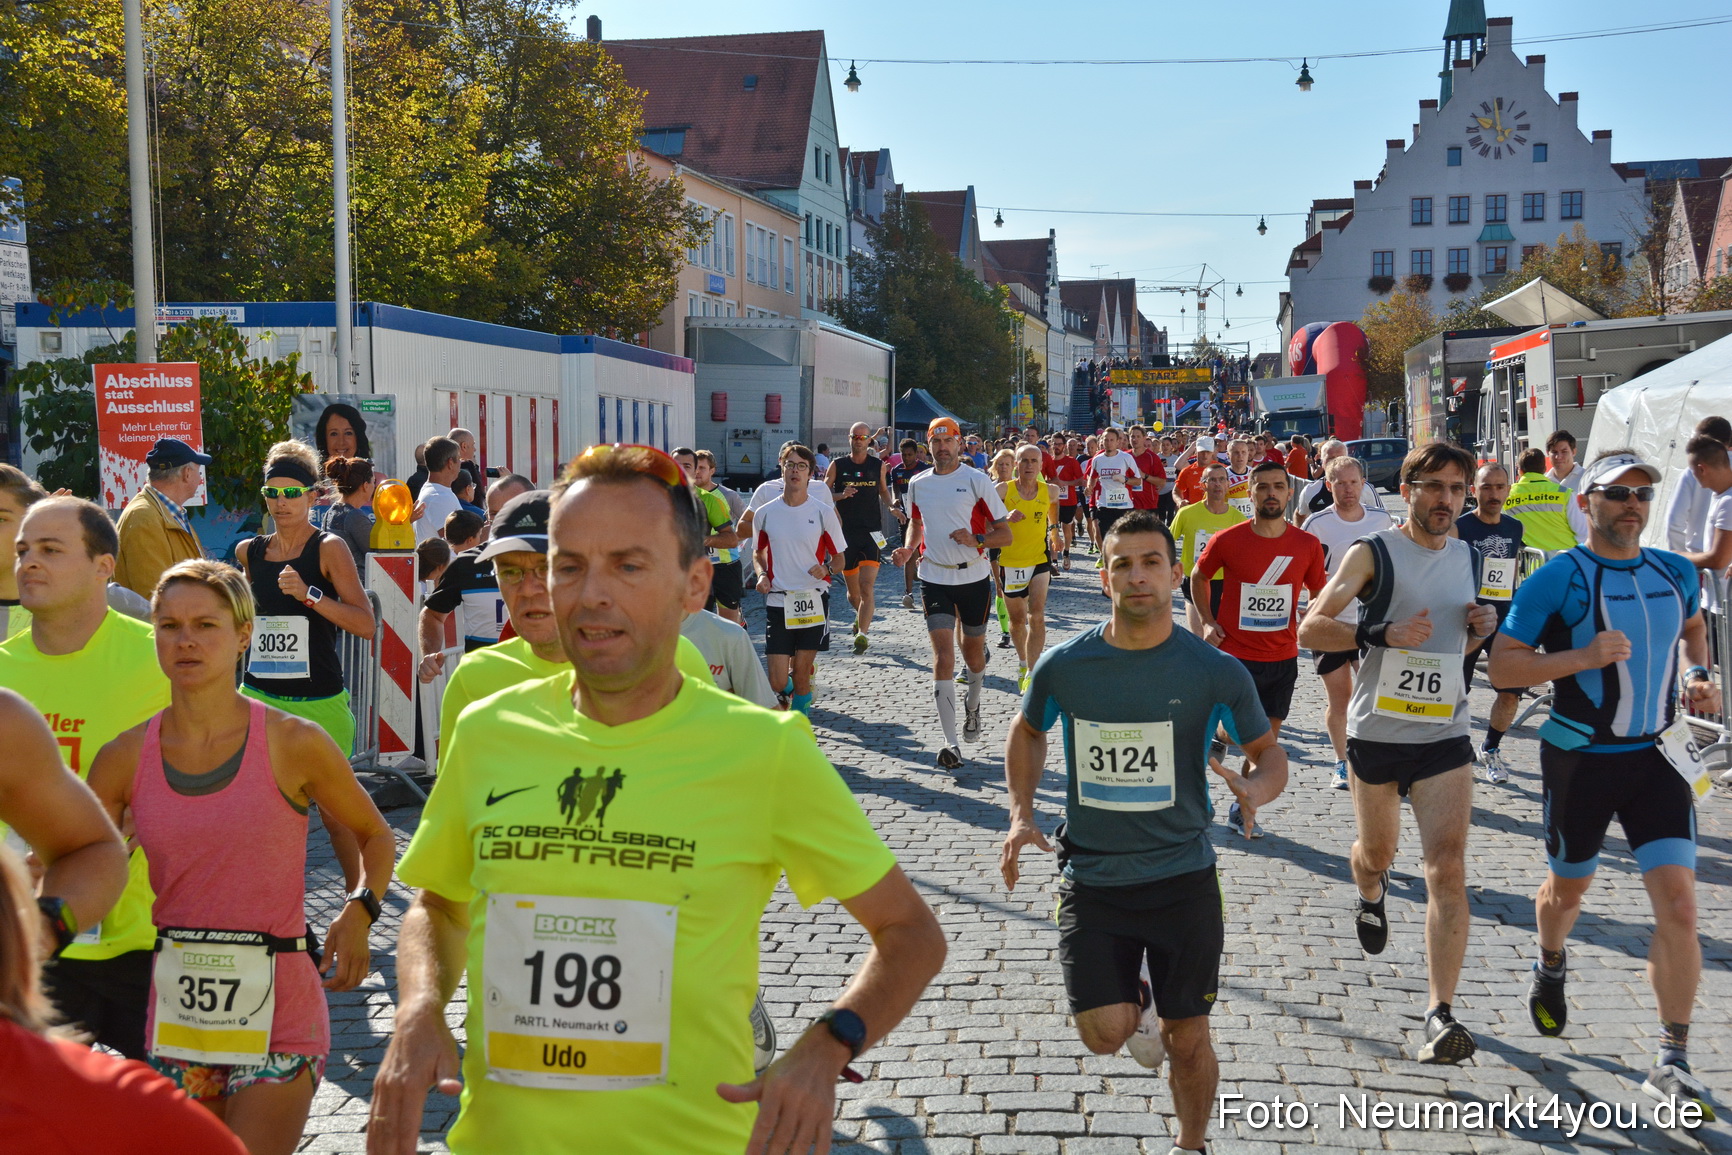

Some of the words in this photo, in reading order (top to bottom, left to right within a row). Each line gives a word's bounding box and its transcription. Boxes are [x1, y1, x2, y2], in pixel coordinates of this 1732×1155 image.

[3, 270, 26, 281] werktags
[104, 373, 193, 389] Abschluss
[1143, 372, 1177, 381] START
[104, 390, 135, 400] statt
[1274, 393, 1306, 401] BOCK
[106, 400, 195, 414] Ausschluss!
[122, 423, 148, 432] Mehr
[149, 422, 178, 432] Lehrer
[180, 422, 192, 431] für
[118, 433, 156, 443] kleinere
[1229, 485, 1246, 495] MAX
[1506, 493, 1560, 506] Org.-Leiter
[1014, 570, 1025, 580] 71
[1487, 570, 1503, 583] 62
[793, 599, 815, 613] 304
[1247, 596, 1285, 611] 2622
[258, 633, 298, 652] 3032
[1407, 656, 1441, 667] BOCK
[1397, 669, 1442, 694] 216
[1394, 691, 1411, 699] PARTL
[1412, 694, 1435, 702] Neumarkt
[1405, 703, 1426, 714] Karl
[1100, 729, 1143, 740] BOCK
[1088, 745, 1158, 773] 3124
[1096, 775, 1115, 784] PARTL
[482, 825, 504, 838] SC
[534, 914, 617, 937] BOCK
[206, 931, 257, 942] DESIGN
[183, 952, 235, 968] BOCK
[523, 949, 622, 1010] 198
[178, 975, 242, 1012] 357
[178, 1013, 198, 1024] PARTL
[514, 1014, 549, 1028] PARTL
[552, 1017, 610, 1032] Neumarkt
[542, 1043, 587, 1069] Udo
